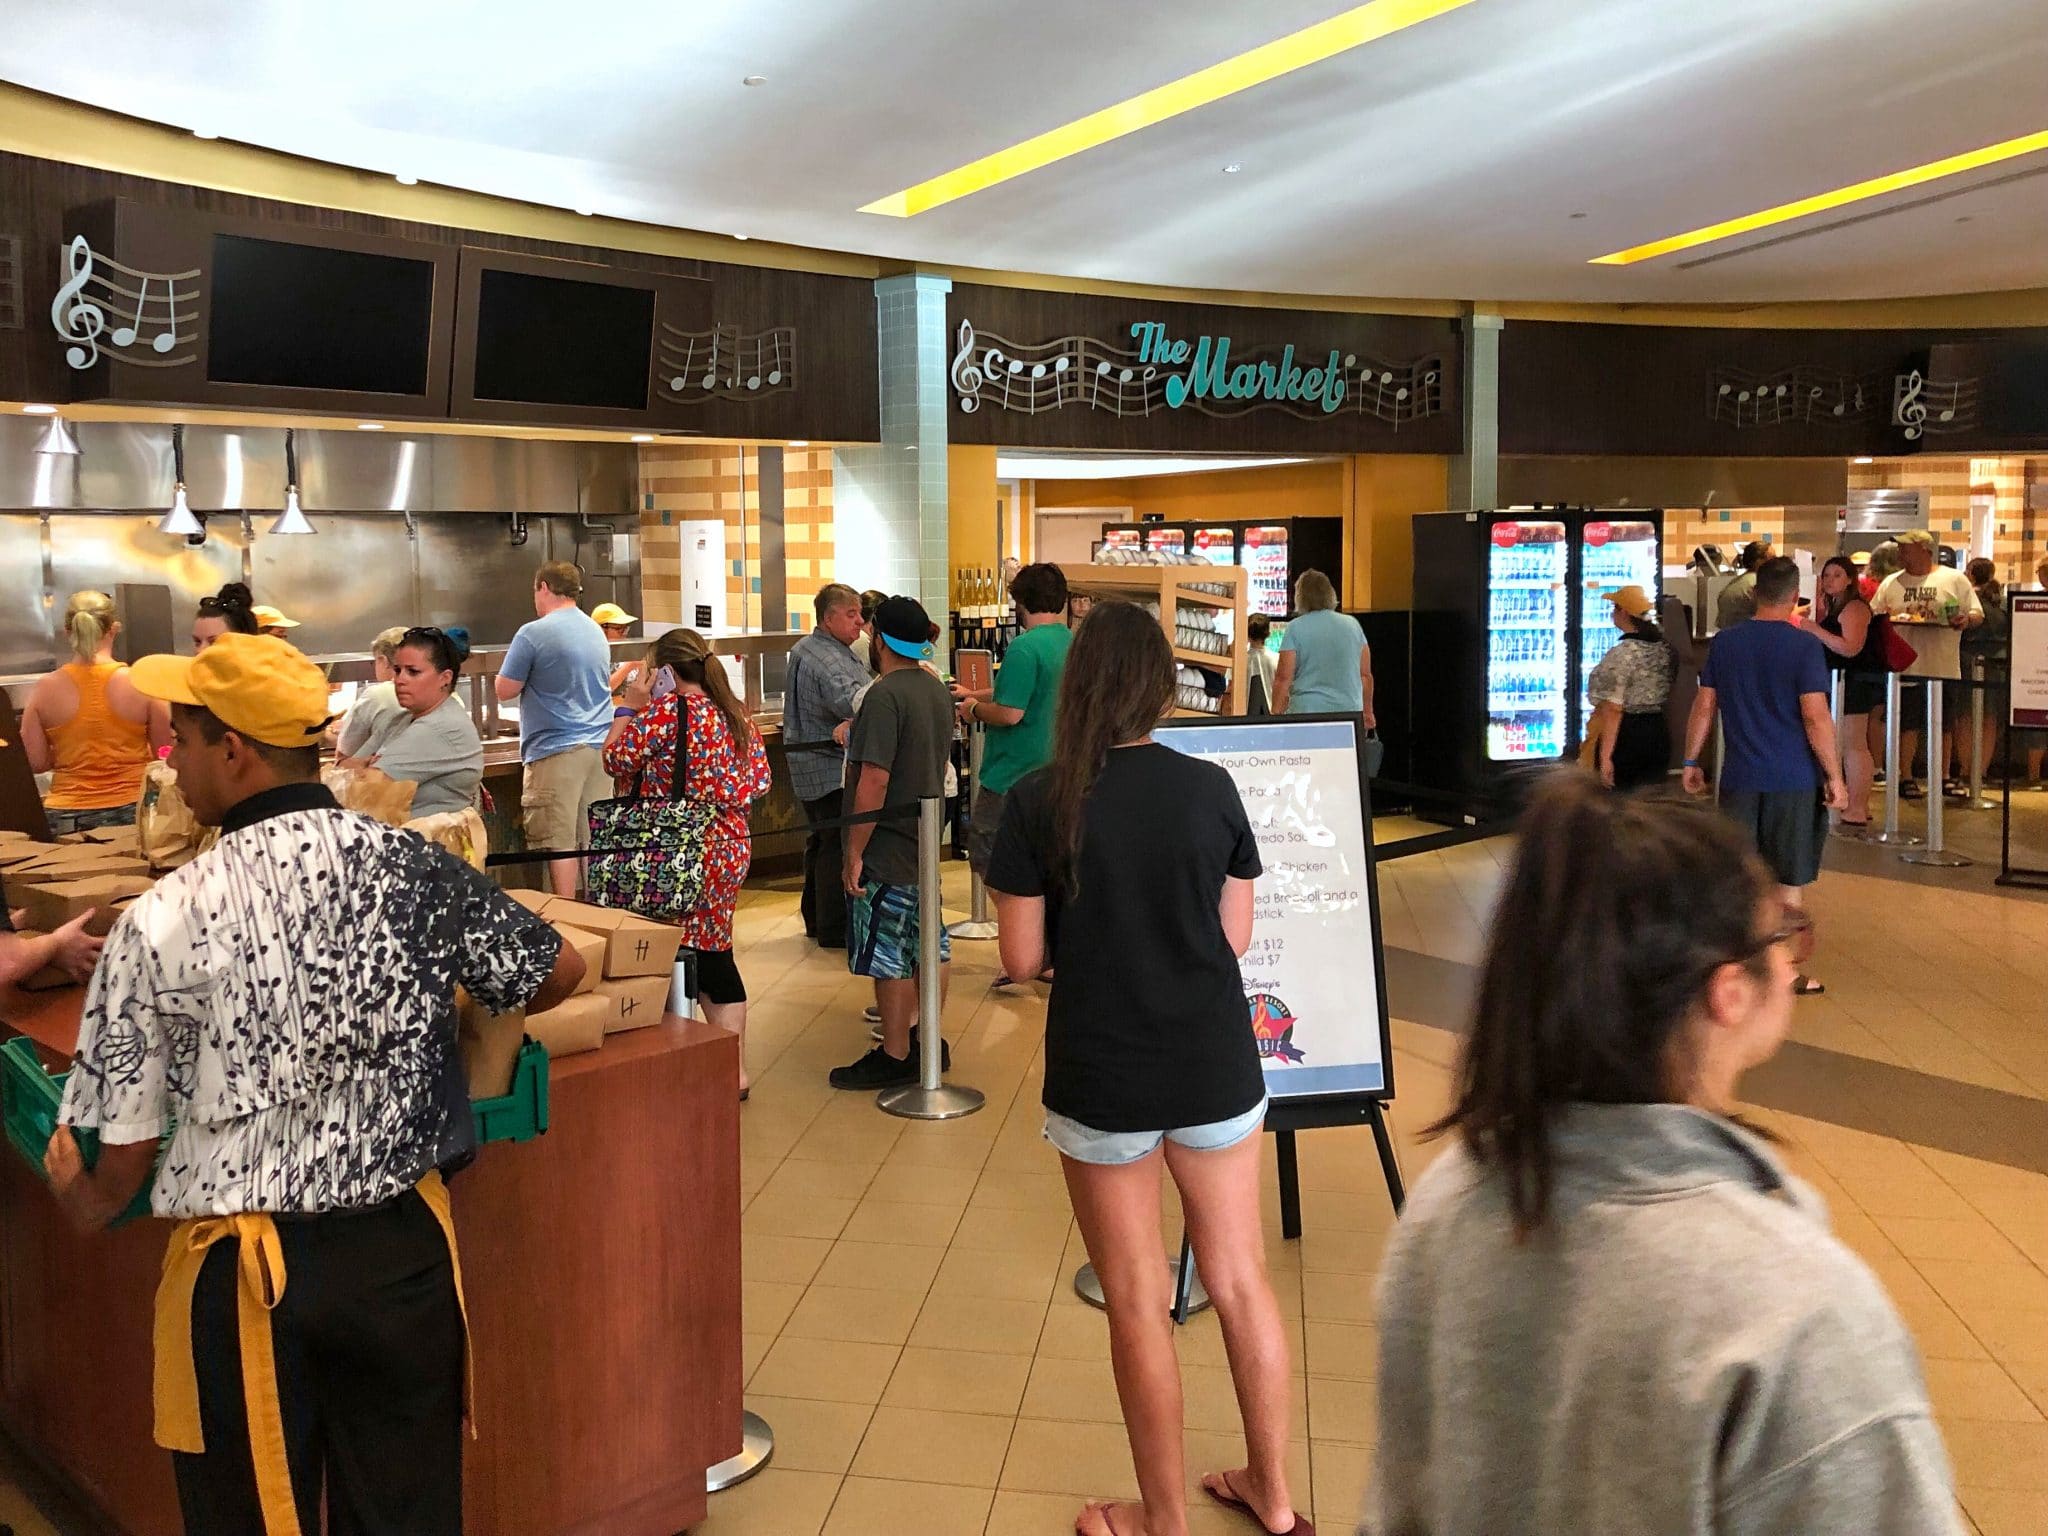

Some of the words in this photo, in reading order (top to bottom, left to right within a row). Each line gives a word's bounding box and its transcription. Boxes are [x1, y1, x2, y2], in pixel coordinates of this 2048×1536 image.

[1131, 321, 1191, 364] The
[1166, 335, 1345, 413] Market
[1279, 755, 1311, 767] Pasta
[1350, 890, 1358, 900] a
[635, 938, 650, 963] H
[1263, 938, 1284, 952] $12
[1267, 953, 1281, 967] $7
[1257, 1040, 1282, 1052] USIC
